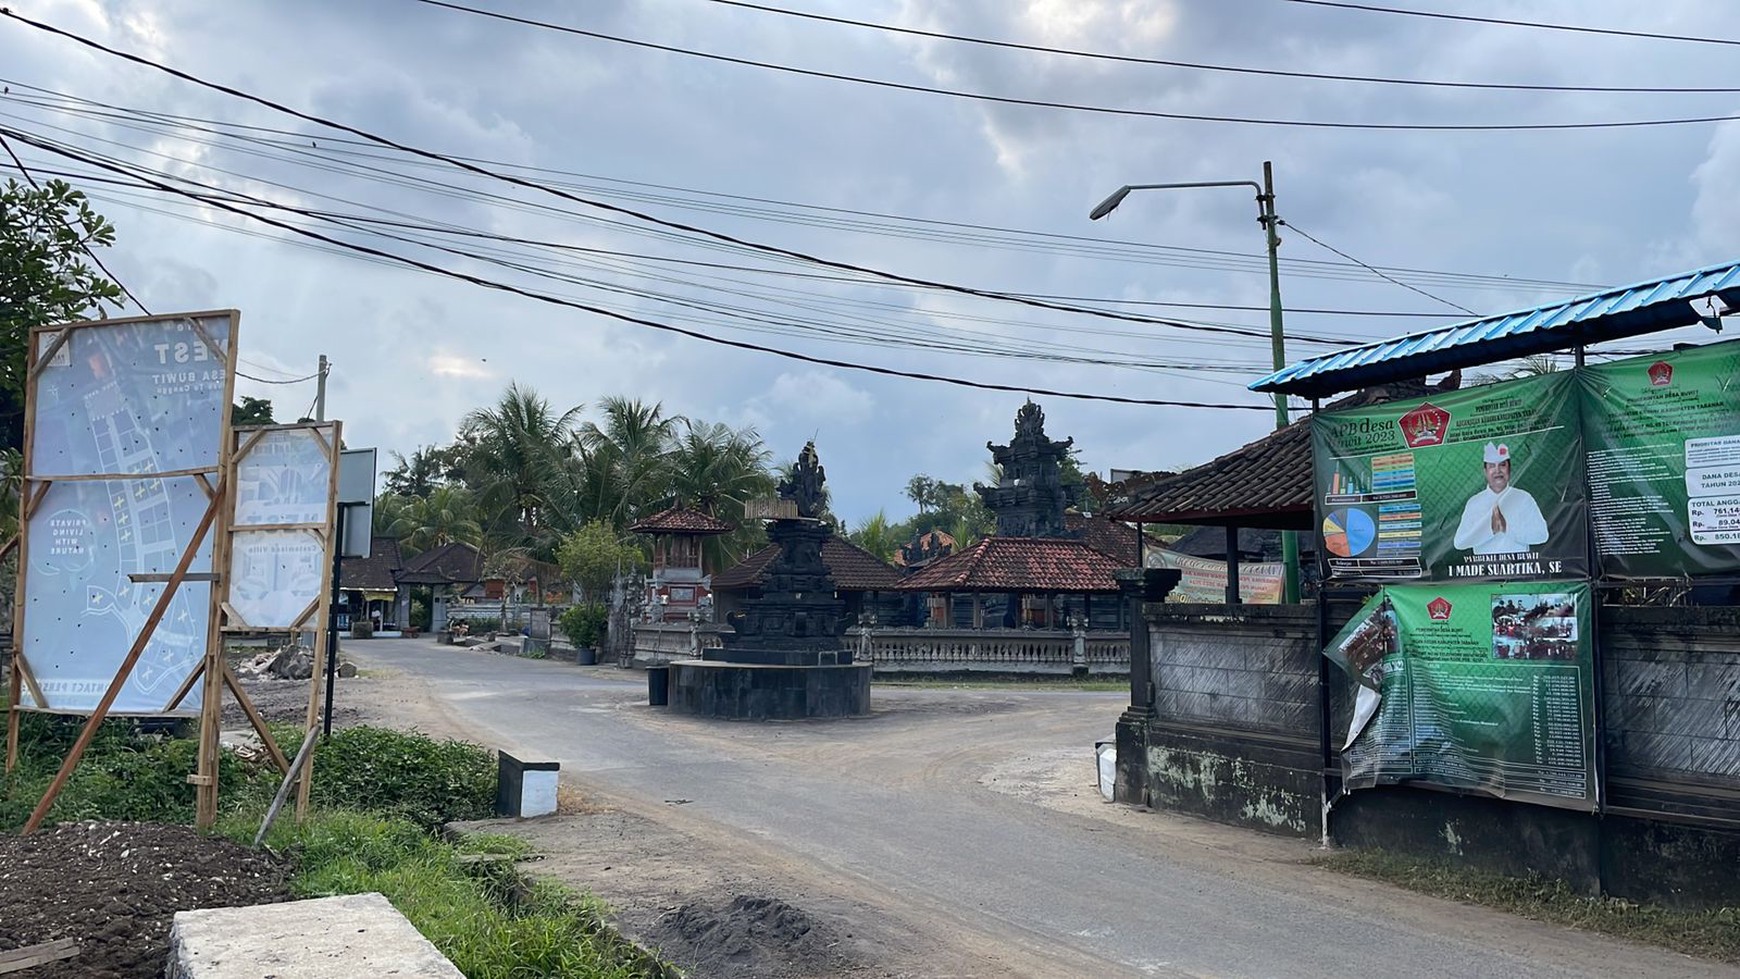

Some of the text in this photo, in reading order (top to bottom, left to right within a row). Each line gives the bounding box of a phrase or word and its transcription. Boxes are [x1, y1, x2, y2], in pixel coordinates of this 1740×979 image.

[1366, 431, 1395, 444] 2023
[1456, 565, 1485, 577] MADE
[1487, 562, 1545, 576] SUARTIKA,
[1549, 561, 1562, 573] SE
